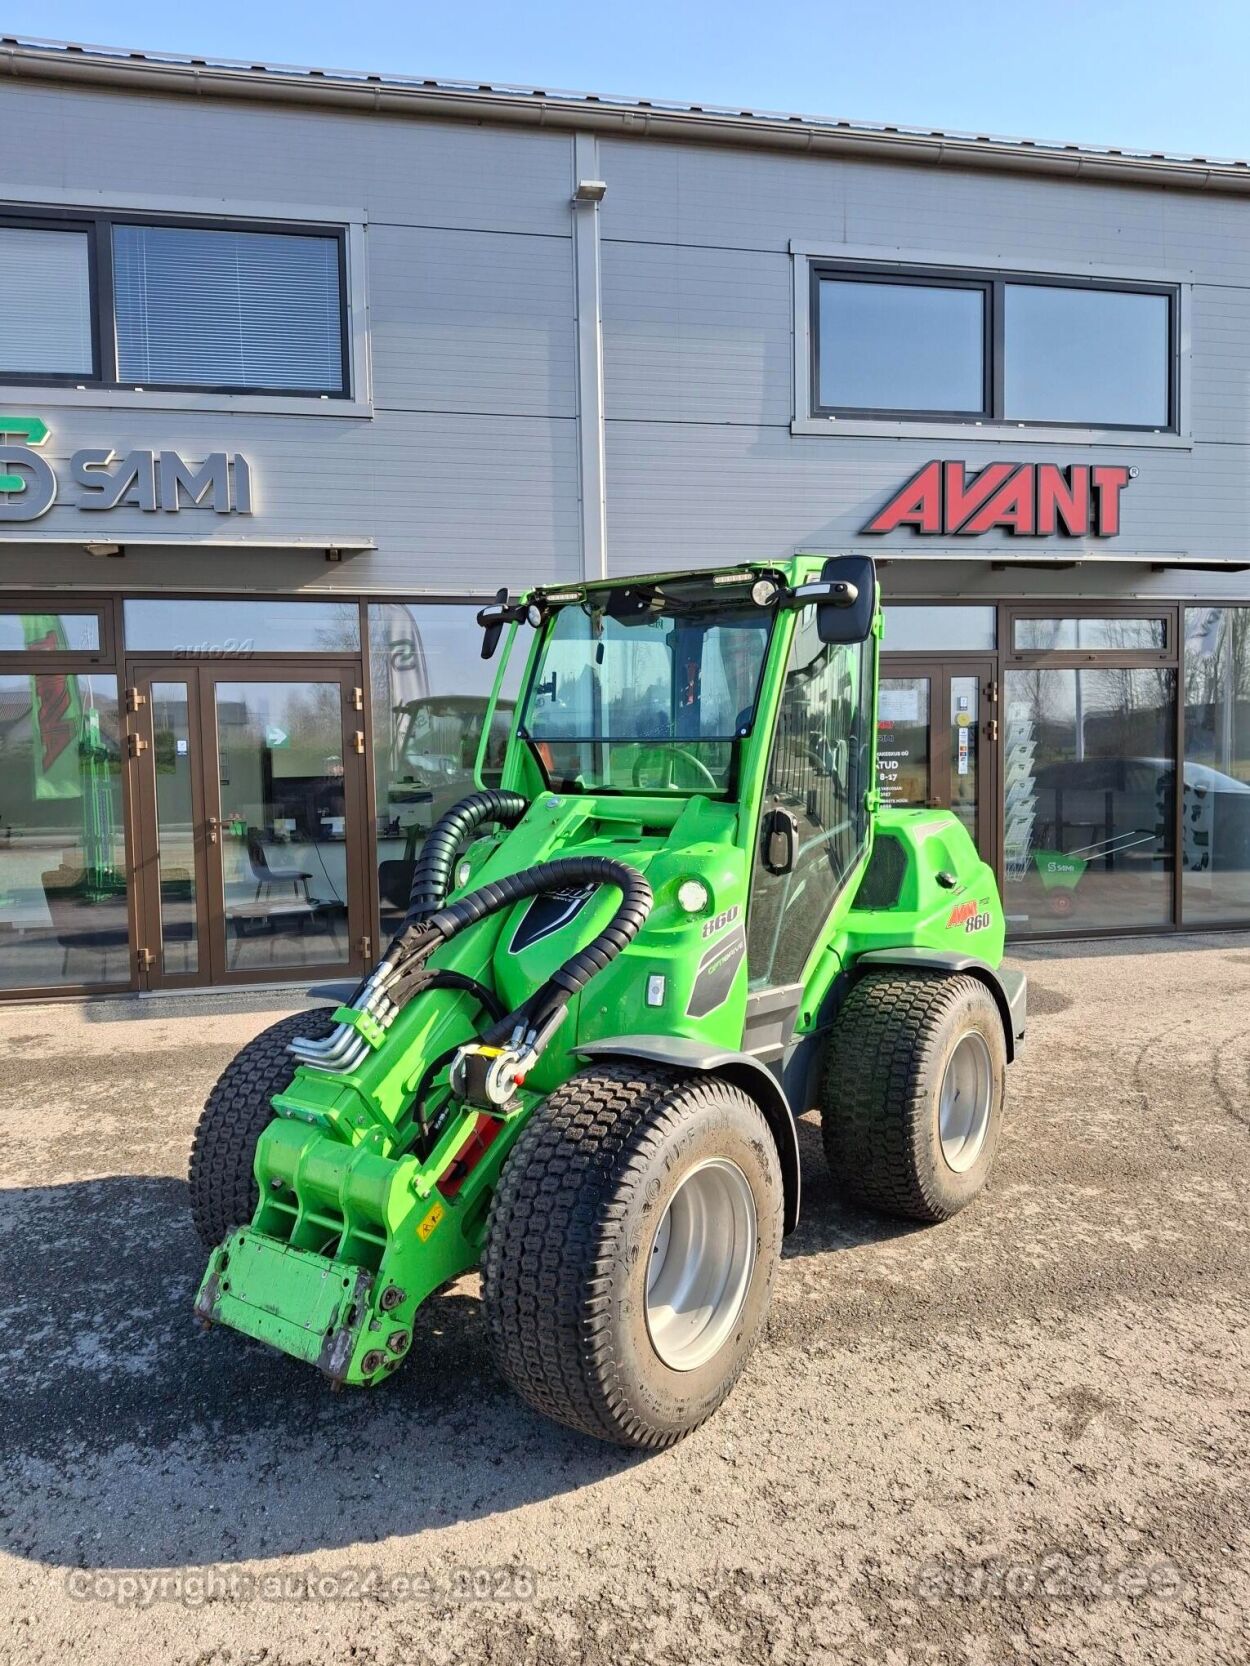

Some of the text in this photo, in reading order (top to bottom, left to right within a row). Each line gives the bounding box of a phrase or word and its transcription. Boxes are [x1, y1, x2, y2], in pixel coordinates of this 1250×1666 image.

[71, 448, 253, 514] SAMI
[702, 907, 738, 937] 860
[965, 912, 990, 933] 860
